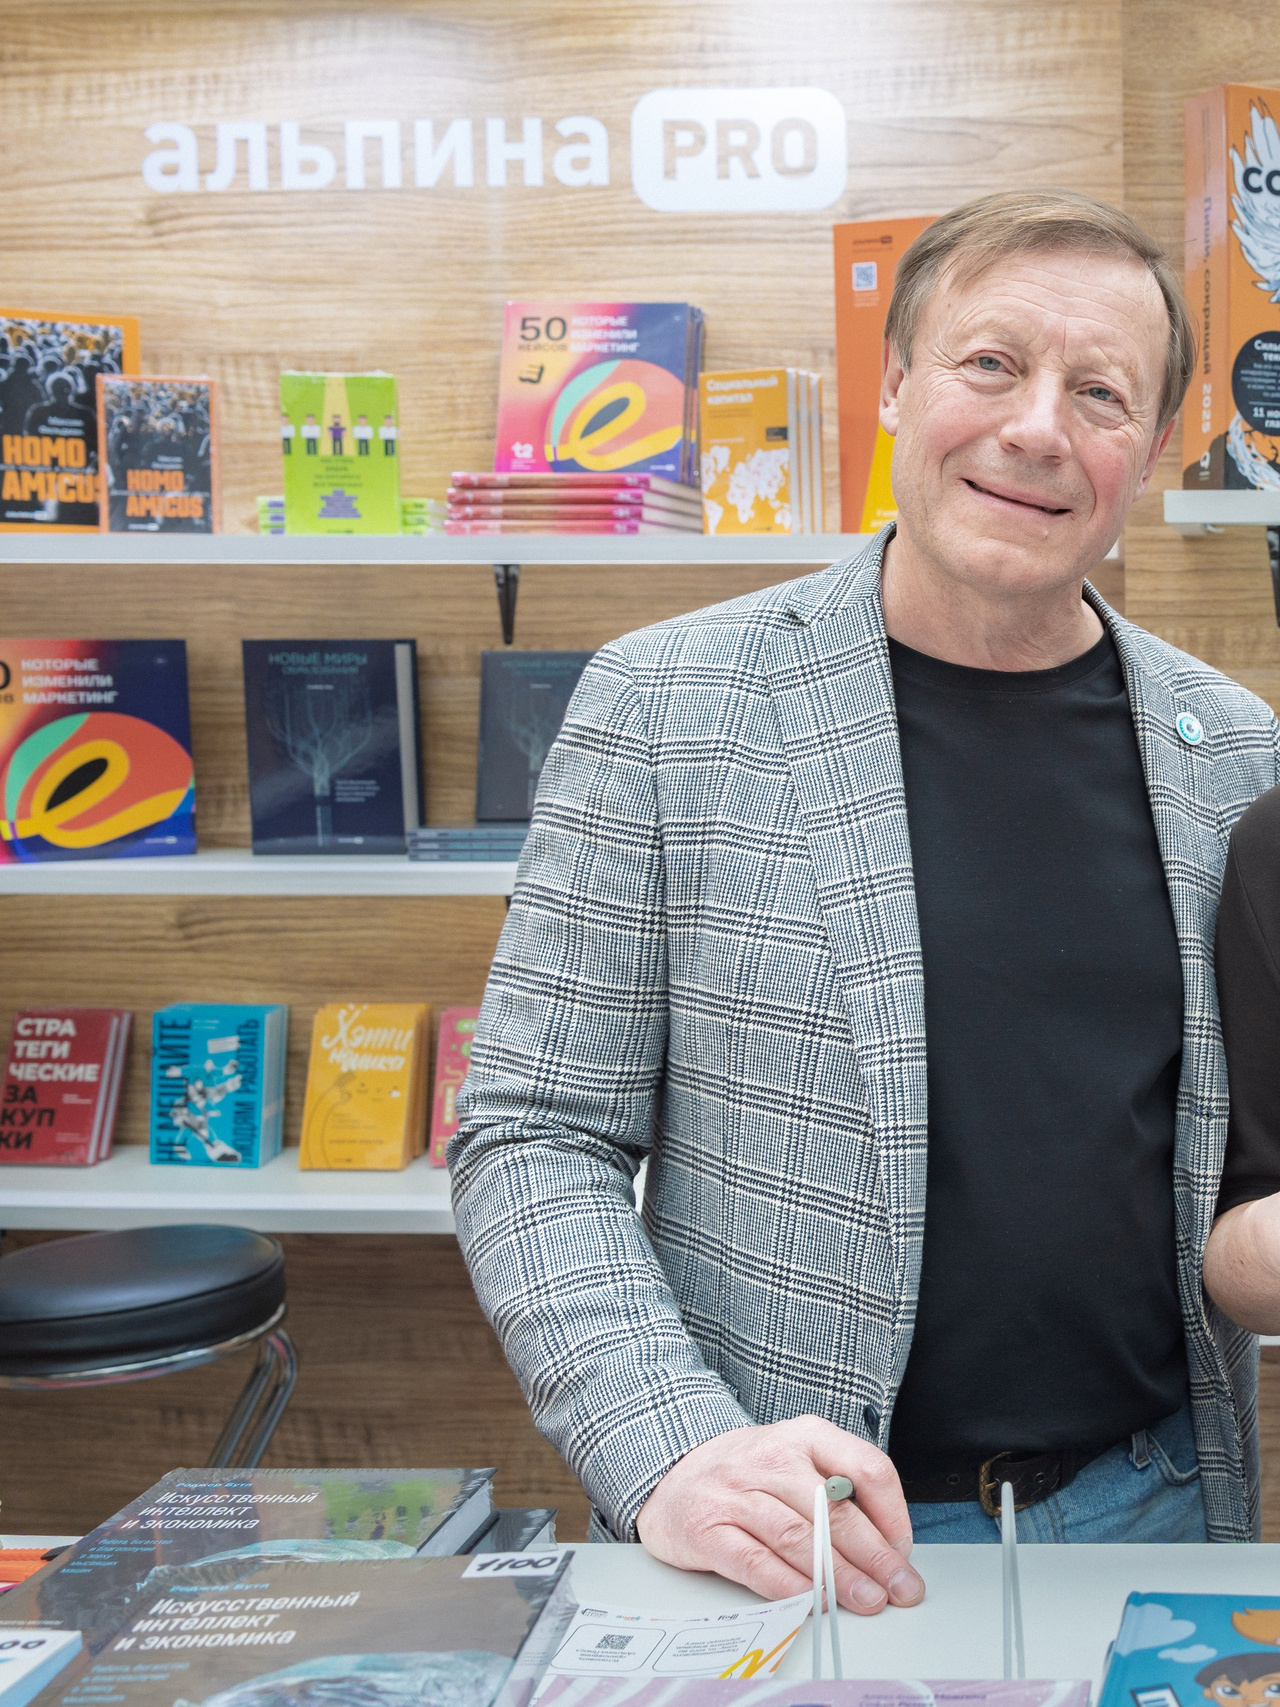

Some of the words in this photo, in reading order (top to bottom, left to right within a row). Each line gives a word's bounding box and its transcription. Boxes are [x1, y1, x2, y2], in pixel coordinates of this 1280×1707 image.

[142, 115, 610, 192] альпина
[662, 117, 818, 181] PRO
[520, 316, 567, 341] 50
[571, 315, 628, 327] КОТОРЫЕ
[1202, 268, 1212, 375] сокращай
[570, 328, 637, 340] ИЗМЕНИЛИ
[570, 341, 640, 354] МАРКЕТИНГ
[1201, 383, 1212, 433] 2025
[1253, 407, 1265, 417] 11
[2, 434, 86, 468] HOMO
[127, 469, 184, 492] HOMO
[126, 496, 203, 517] AMICUS
[21, 658, 99, 671] КОТОРЫЕ
[22, 675, 113, 687] ИЗМЕНИЛИ
[22, 691, 118, 704] МАРКЕТИНГ
[17, 1018, 77, 1037] СТРА
[14, 1040, 71, 1059] ТЕГИ
[236, 1019, 260, 1094] РАБОТАТЬ
[9, 1062, 101, 1082] ЧЕСКИЕ
[157, 1019, 192, 1130] МЕШАЙТЕ
[5, 1084, 38, 1104] ЗА
[0, 1108, 55, 1126] КУП
[0, 1131, 33, 1149] КИ
[155, 1137, 188, 1163] НЕ
[154, 1491, 320, 1506] Искусственный
[138, 1506, 252, 1516] интеллект
[120, 1519, 141, 1529] и
[140, 1519, 261, 1529] экономика
[476, 1556, 558, 1571] 1100
[169, 1584, 230, 1593] Роджер
[233, 1583, 270, 1591] Бутл
[148, 1591, 361, 1617] Искусственный
[131, 1613, 281, 1633] интеллект
[113, 1637, 136, 1651] и
[139, 1630, 297, 1651] экономика
